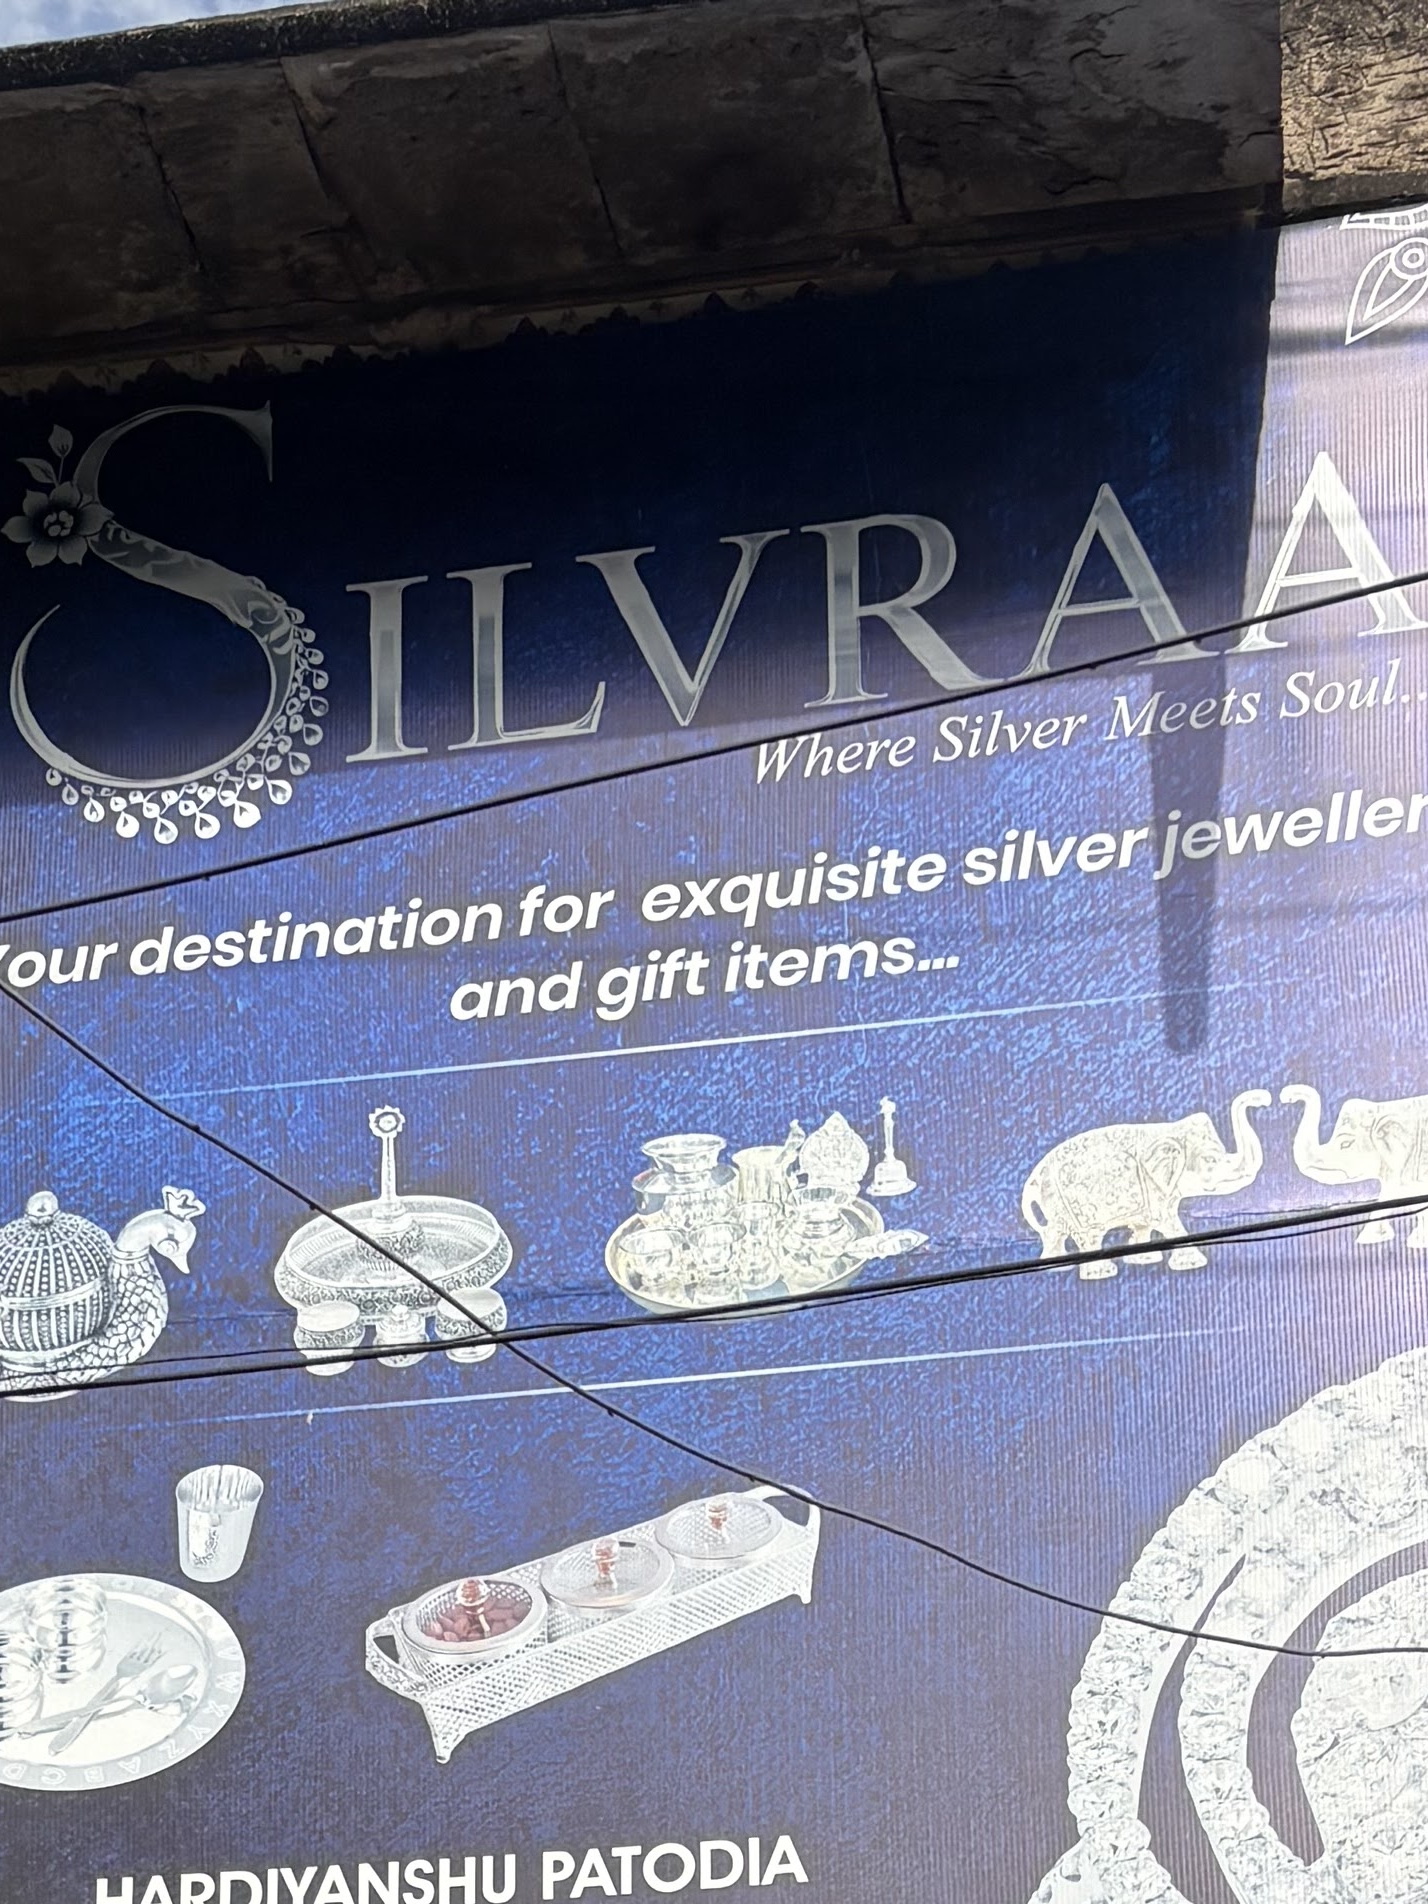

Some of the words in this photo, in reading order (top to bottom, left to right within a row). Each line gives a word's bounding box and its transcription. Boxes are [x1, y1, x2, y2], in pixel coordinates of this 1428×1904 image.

[755, 733, 917, 786] Where
[933, 708, 1089, 765] Silver
[1102, 683, 1261, 745] Meets
[128, 880, 505, 978] destination
[515, 880, 616, 942] for
[640, 845, 948, 930] exquisite
[962, 824, 1151, 888] silver
[449, 958, 581, 1022] and
[596, 941, 710, 1023] gift
[725, 932, 962, 996] items...
[541, 1833, 809, 1902] PATODIA
